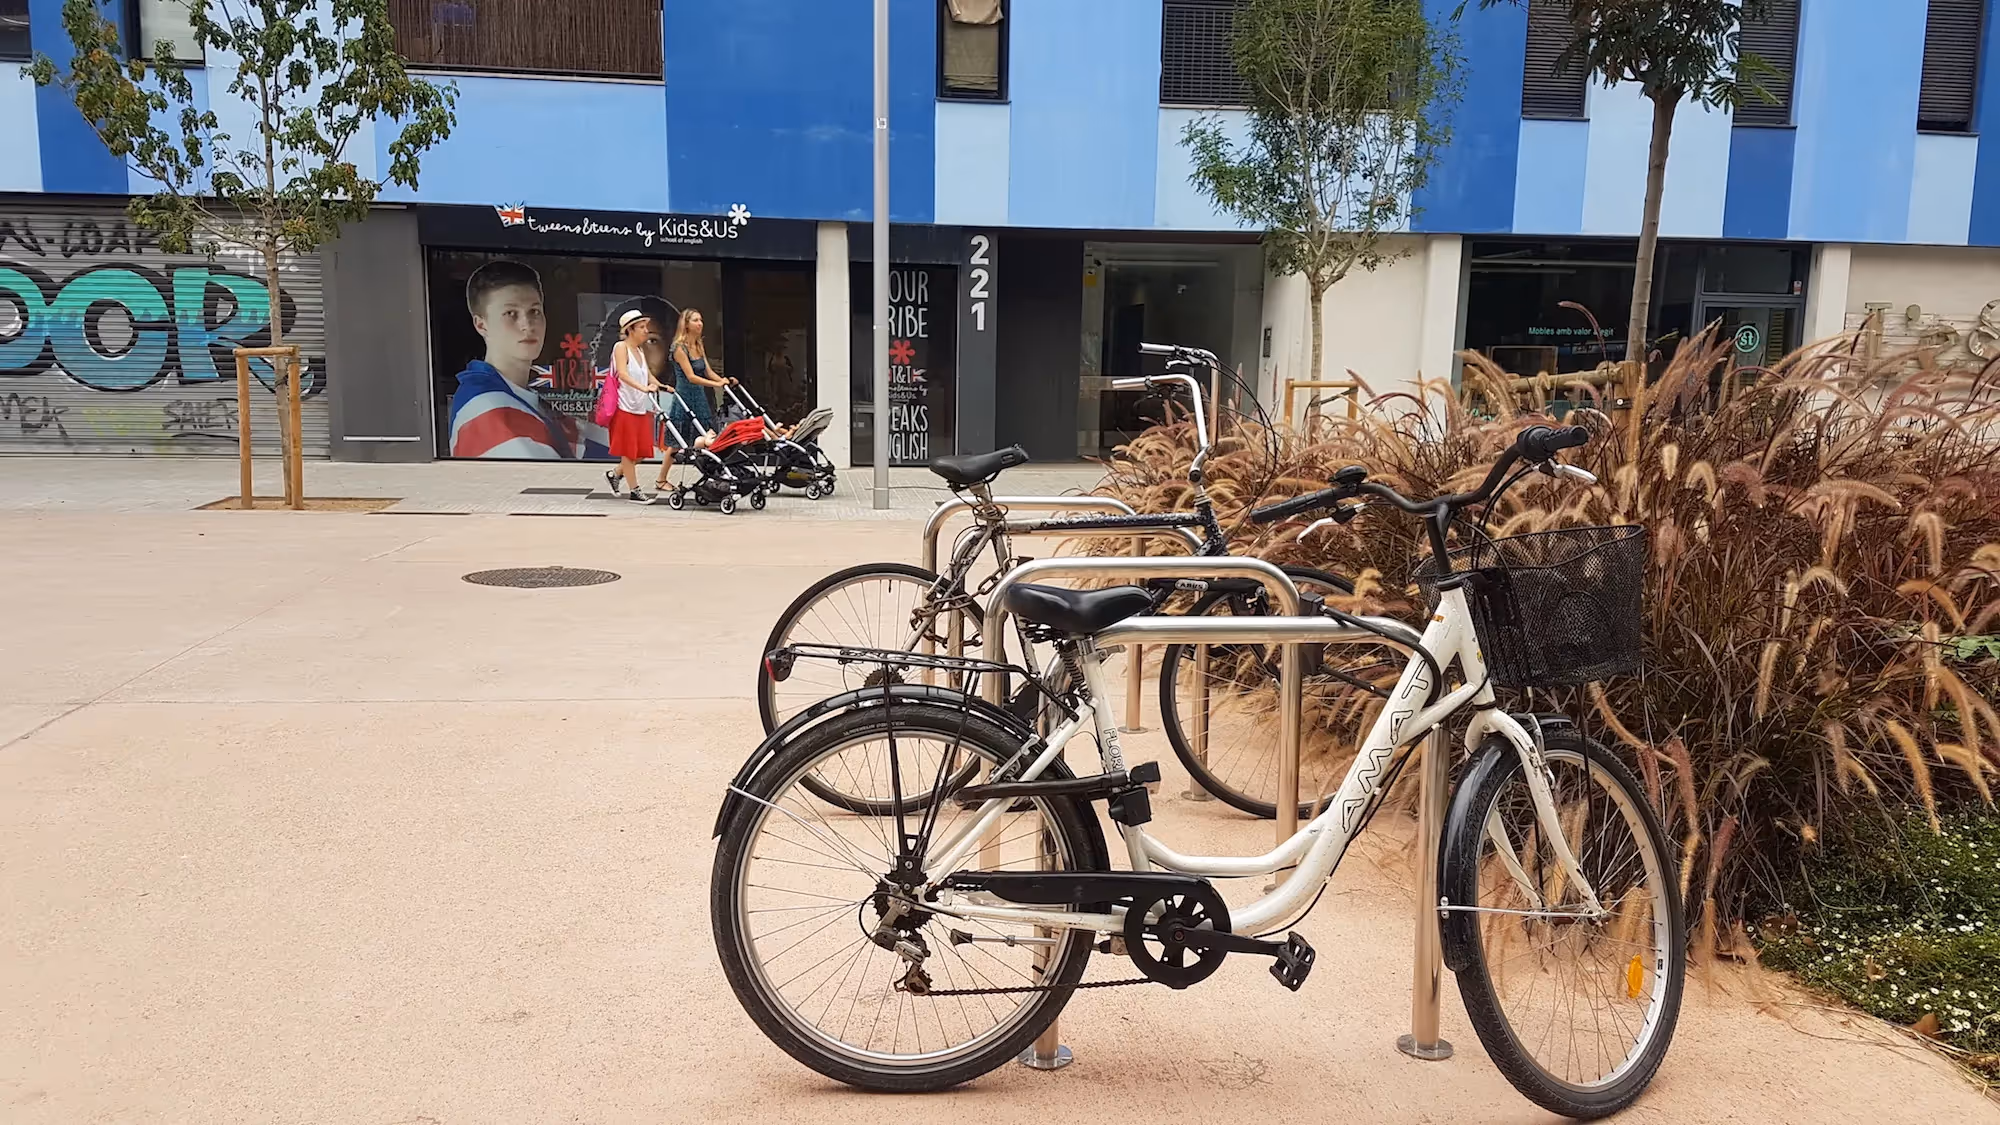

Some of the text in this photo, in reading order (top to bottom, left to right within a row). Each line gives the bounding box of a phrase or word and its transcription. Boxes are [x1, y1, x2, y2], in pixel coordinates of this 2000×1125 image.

[527, 216, 738, 247] tweens&teens by Kids&Us
[888, 270, 929, 305] OUR
[970, 234, 989, 331] 221
[888, 305, 929, 338] RIBE
[1528, 326, 1554, 336] Mobles
[1556, 326, 1572, 336] amb
[1573, 327, 1591, 336] valor
[891, 365, 912, 384] T&T
[888, 391, 917, 400] ids&Us
[888, 404, 928, 432] EAKS
[888, 432, 928, 460] GLISH
